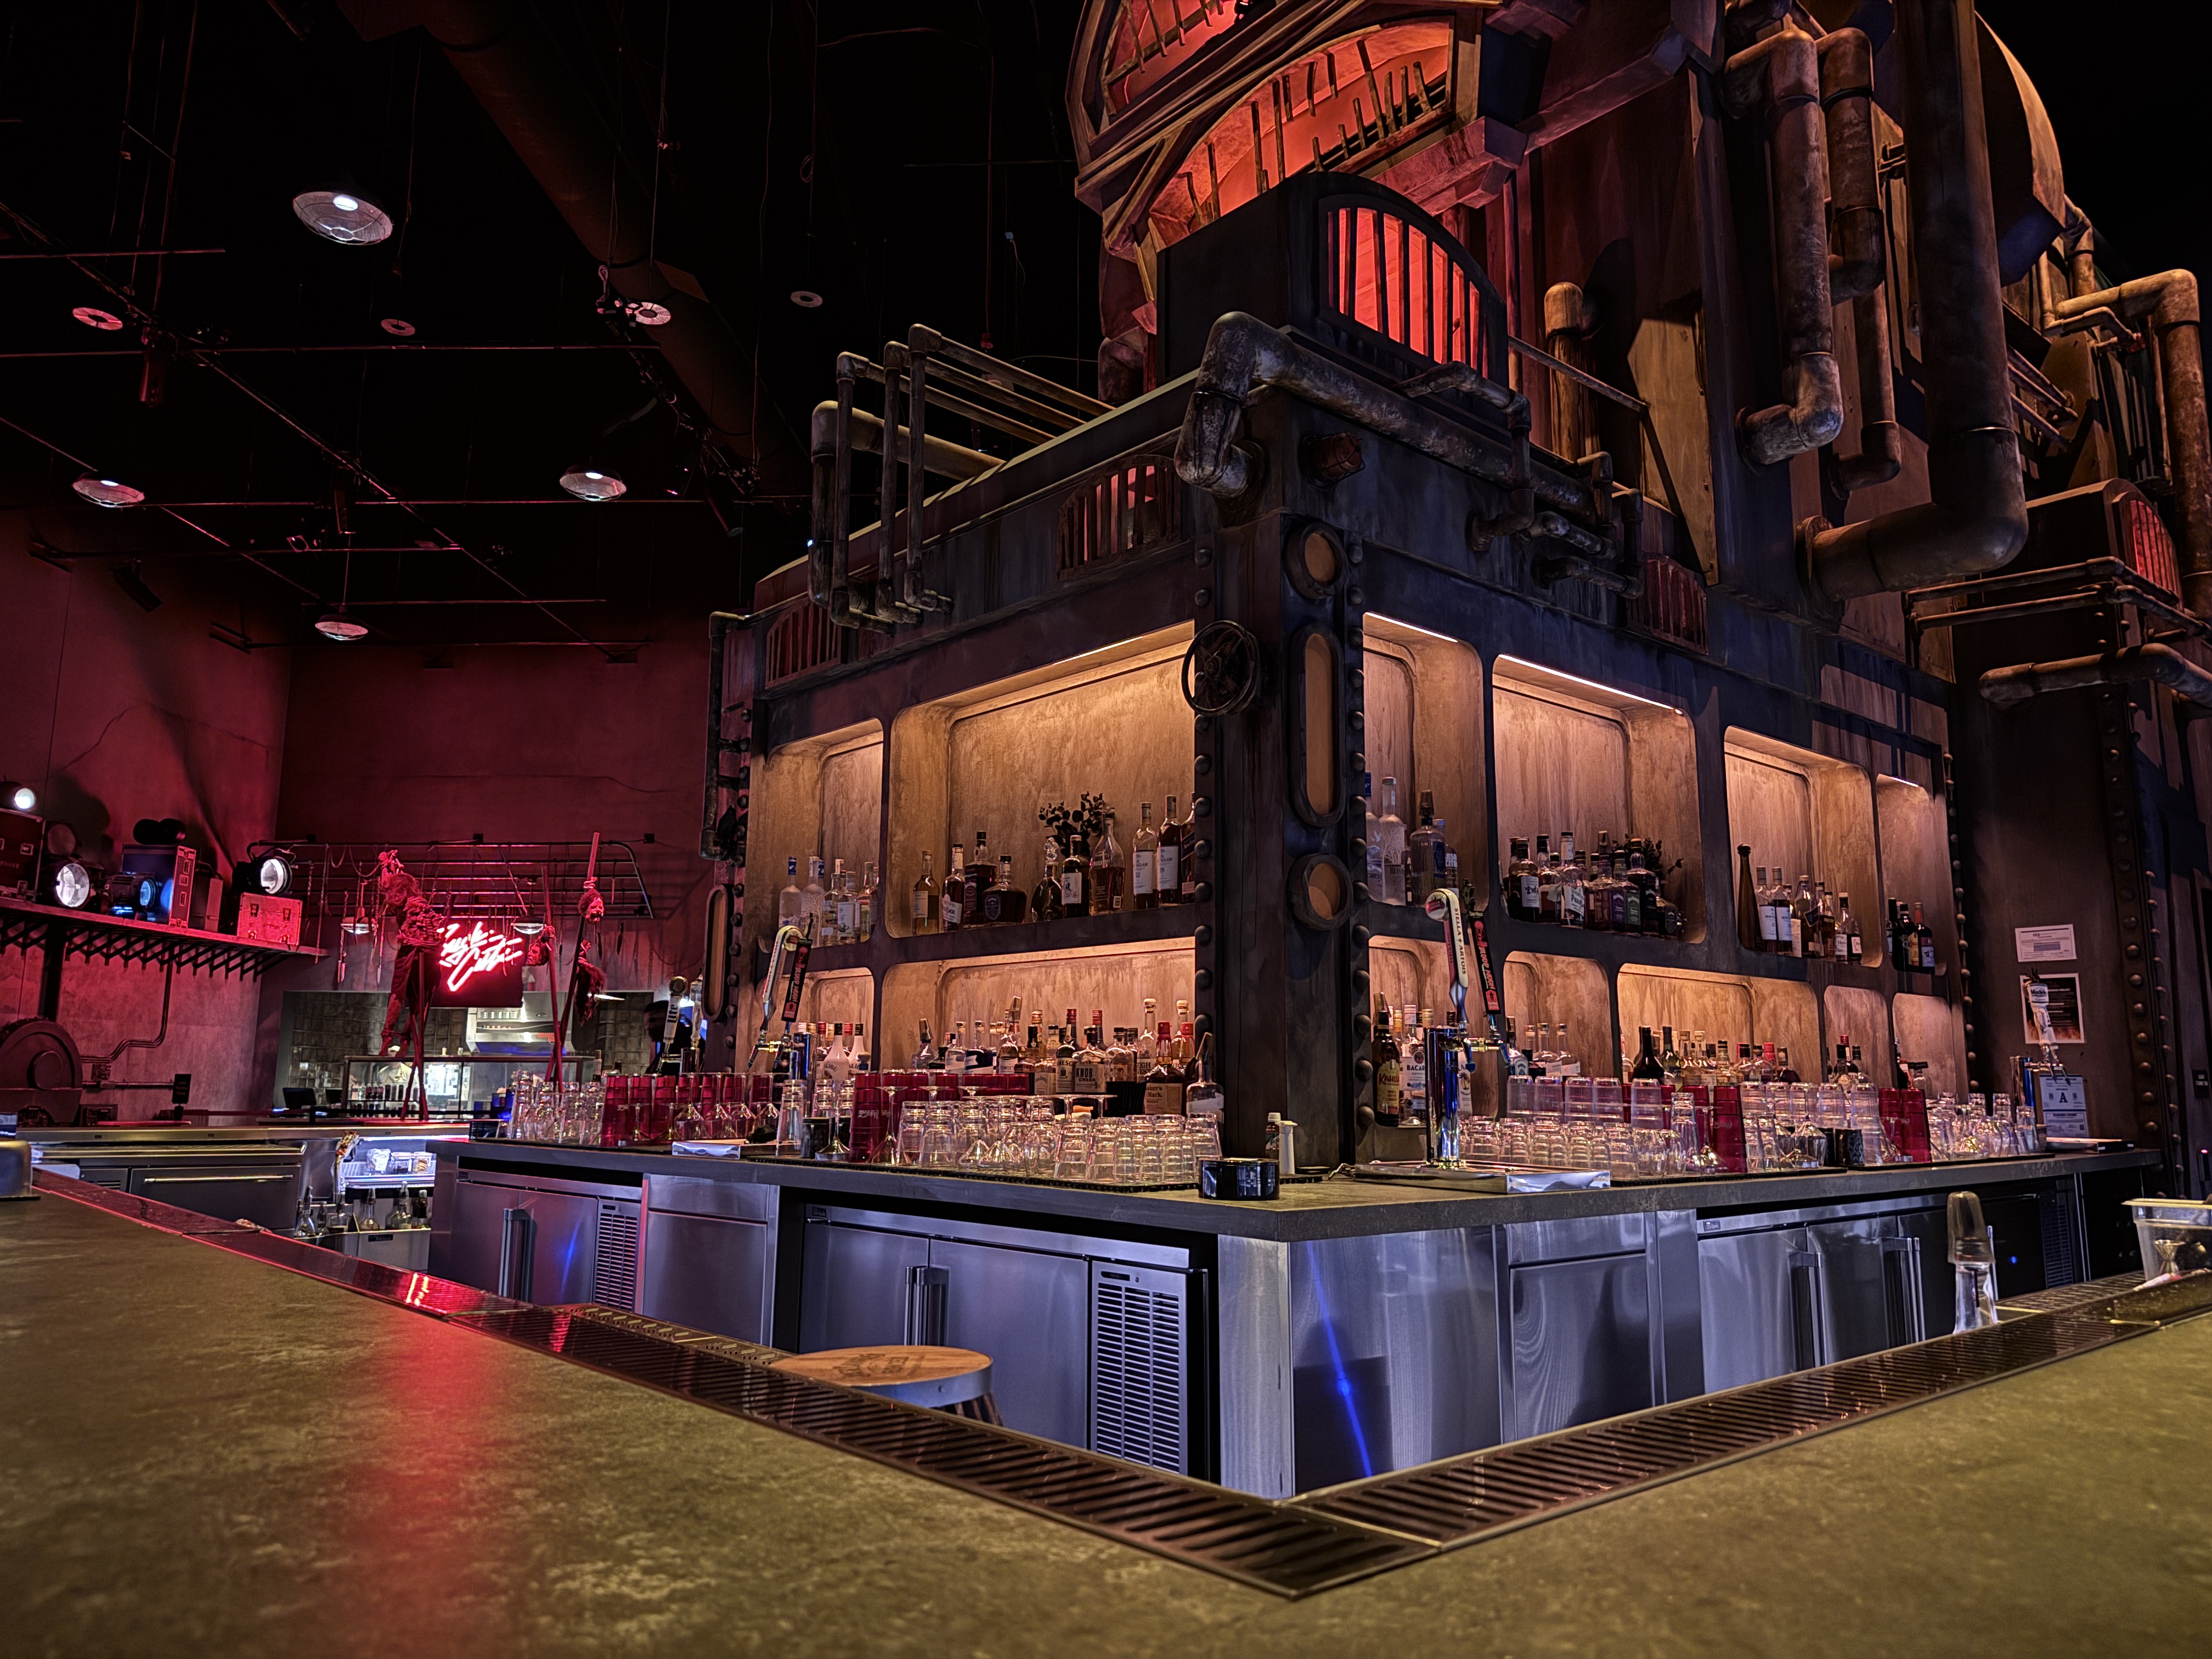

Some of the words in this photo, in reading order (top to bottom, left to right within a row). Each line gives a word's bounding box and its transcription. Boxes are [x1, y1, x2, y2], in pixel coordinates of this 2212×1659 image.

[1459, 945, 1467, 975] ARTOIS
[1479, 946, 1489, 968] BLOOD
[1485, 969, 1496, 990] MOON
[667, 1004, 678, 1023] Lite
[1076, 1068, 1093, 1078] KNOB
[2059, 1092, 2068, 1103] A
